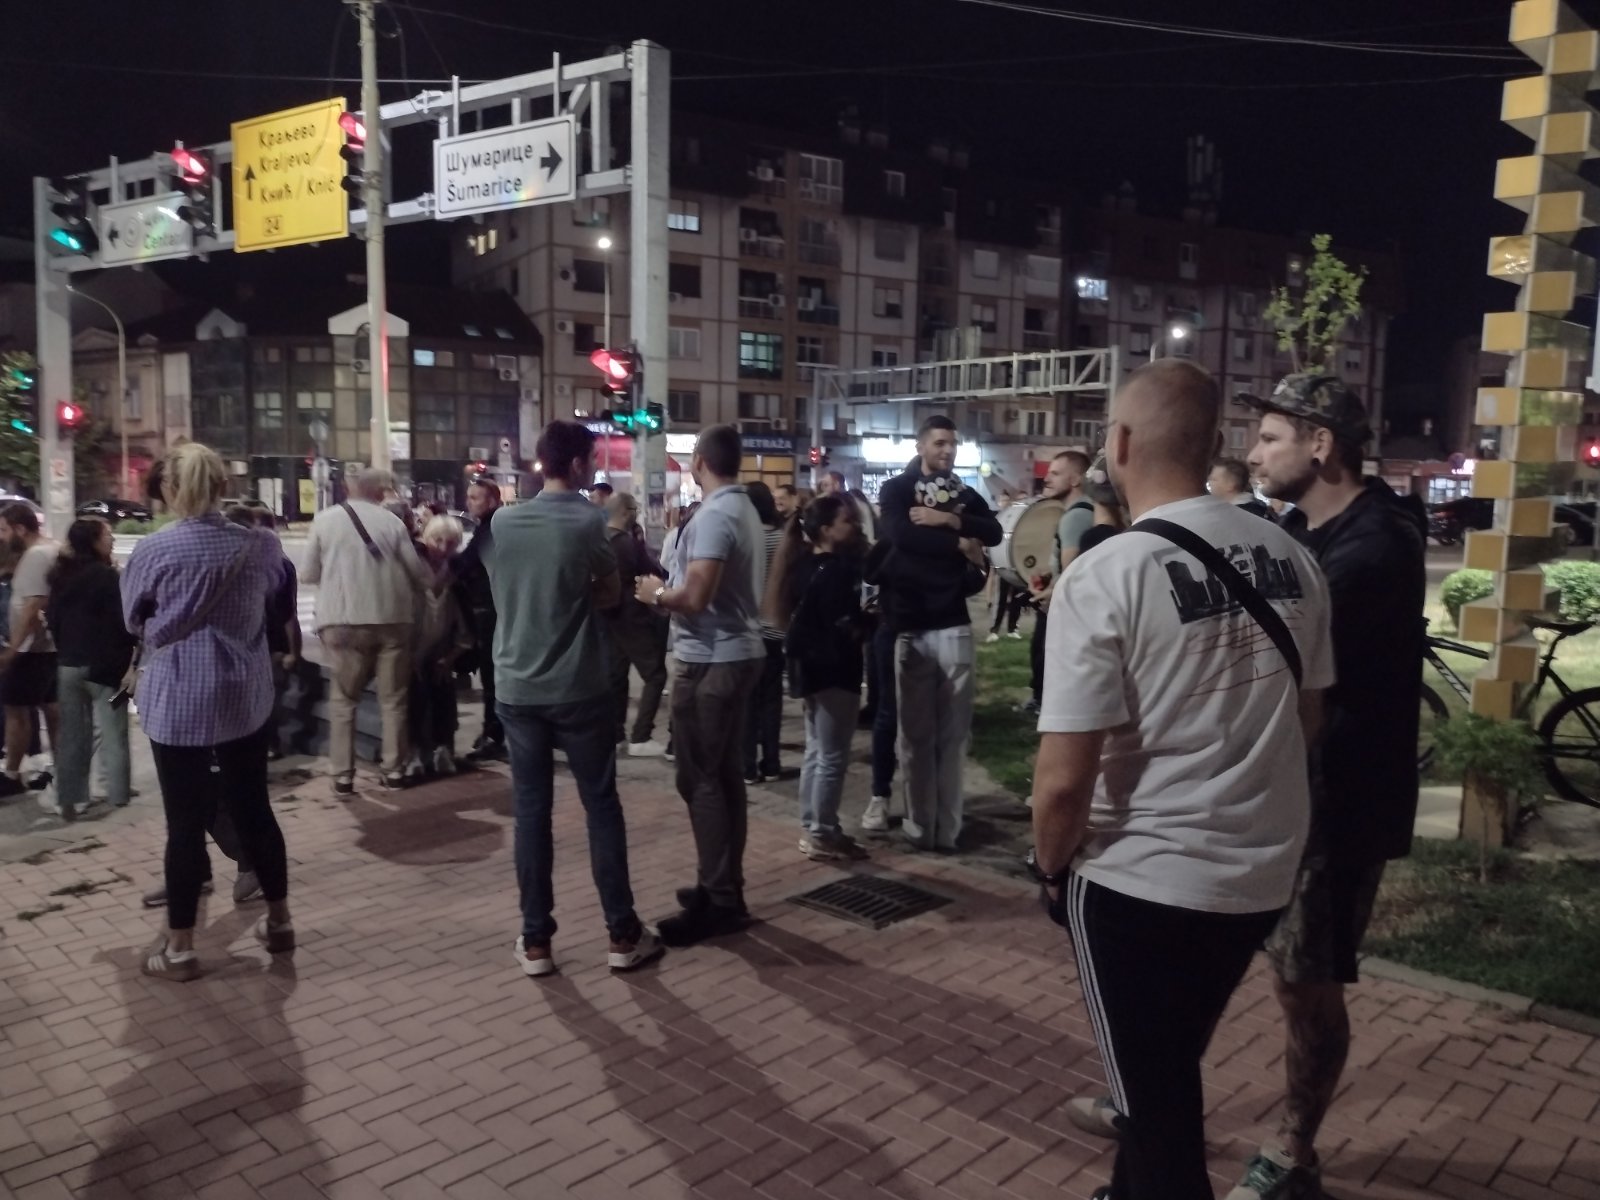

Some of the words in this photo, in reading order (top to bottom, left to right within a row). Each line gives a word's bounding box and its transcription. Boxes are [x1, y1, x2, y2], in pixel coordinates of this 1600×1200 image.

[258, 123, 316, 150] Краљево
[259, 151, 311, 173] Kraljevo
[446, 143, 534, 176] Шумарице
[260, 183, 293, 204] Кнић
[447, 177, 523, 202] Šumarice
